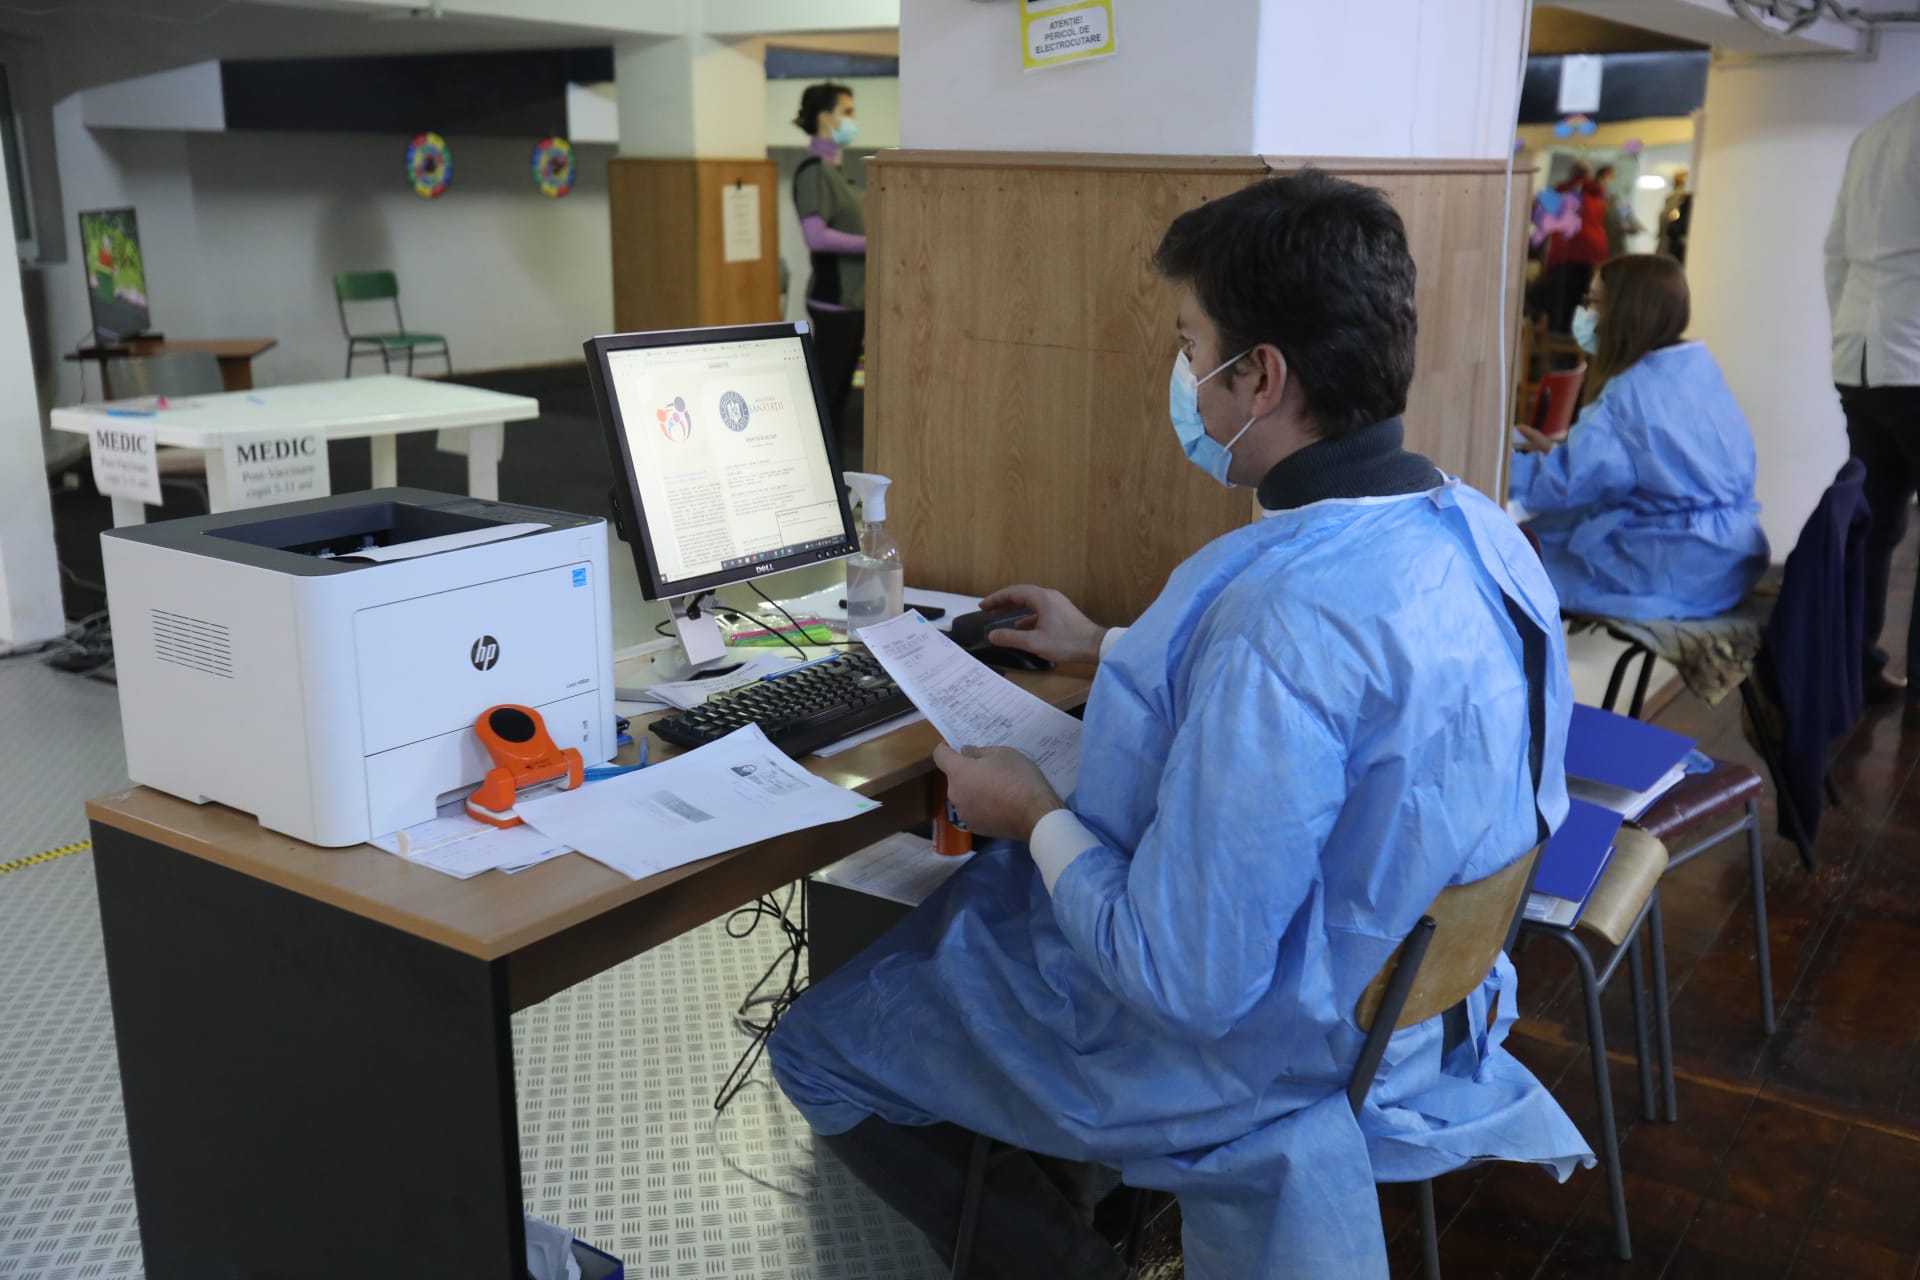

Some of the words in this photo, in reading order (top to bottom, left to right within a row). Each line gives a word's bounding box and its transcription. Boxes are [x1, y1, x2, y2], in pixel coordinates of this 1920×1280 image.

[1035, 33, 1102, 54] ELECTROCUTARE
[1044, 28, 1078, 41] PERICOL
[1079, 25, 1090, 34] DE
[96, 429, 148, 455] MEDIC
[236, 435, 316, 464] MEDIC
[755, 562, 775, 574] DELL
[473, 635, 498, 671] hp
